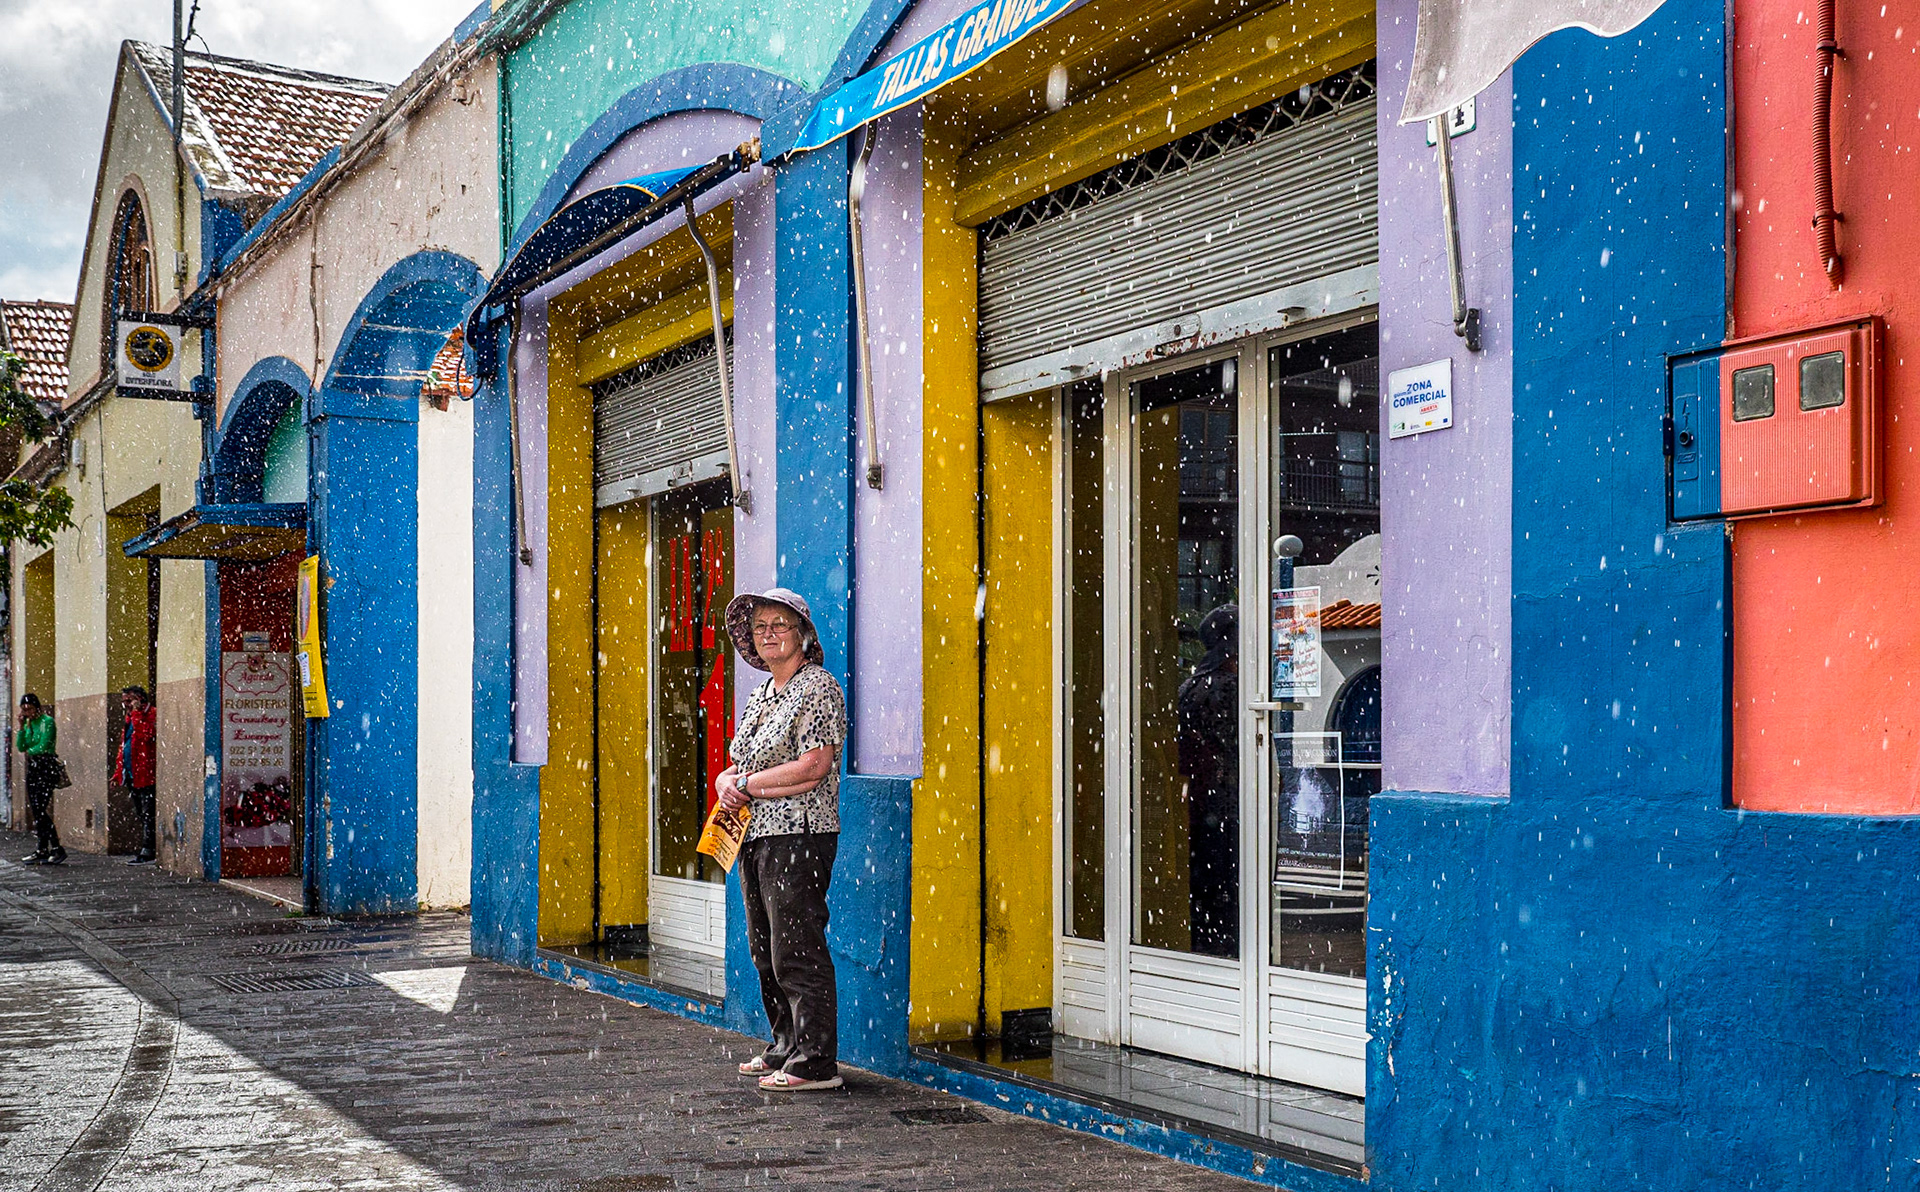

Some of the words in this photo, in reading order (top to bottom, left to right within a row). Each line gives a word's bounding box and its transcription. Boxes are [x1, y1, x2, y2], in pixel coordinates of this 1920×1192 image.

[872, 27, 955, 109] TALLAS
[952, 0, 1052, 68] GRANDE
[1406, 379, 1432, 392] ZONA
[1393, 389, 1446, 409] COMERCIAL
[669, 535, 694, 652] LA
[277, 716, 288, 728] y
[230, 746, 245, 755] 922
[261, 746, 271, 755] 24
[273, 746, 284, 755] 02
[230, 758, 246, 767] 629
